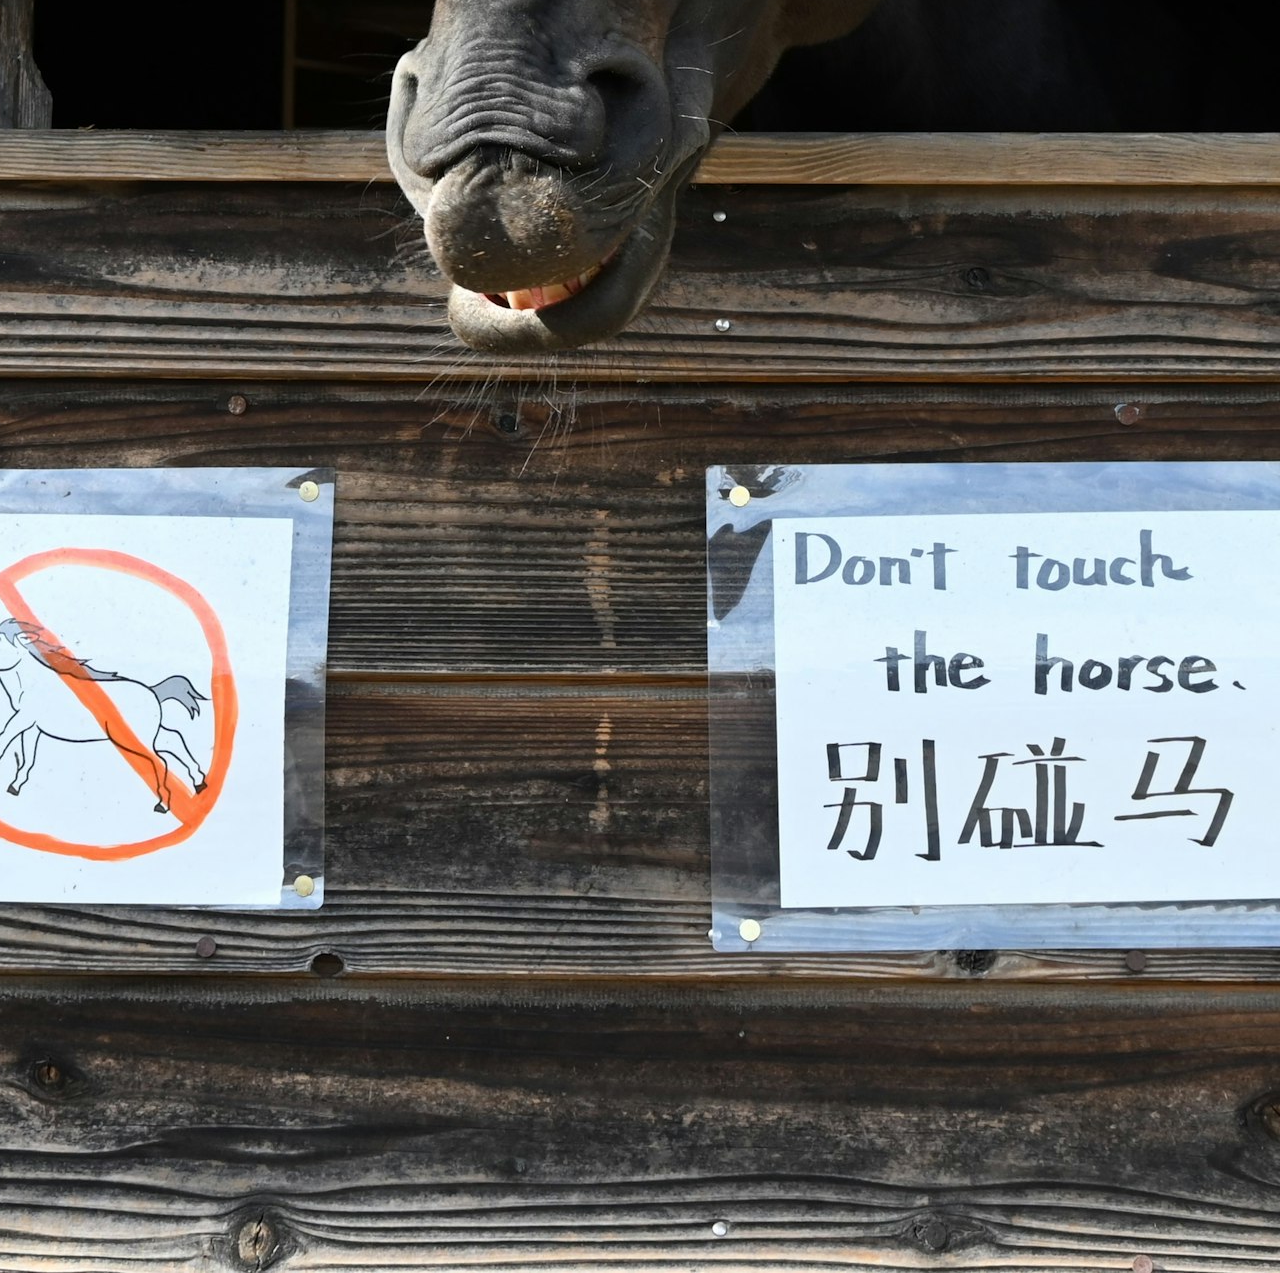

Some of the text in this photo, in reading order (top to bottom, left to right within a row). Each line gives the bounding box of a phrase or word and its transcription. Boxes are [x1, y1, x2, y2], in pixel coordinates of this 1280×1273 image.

[795, 529, 1193, 591] Don't touch
[873, 630, 1246, 695] the horse.
[823, 736, 1234, 861] 别碰马
